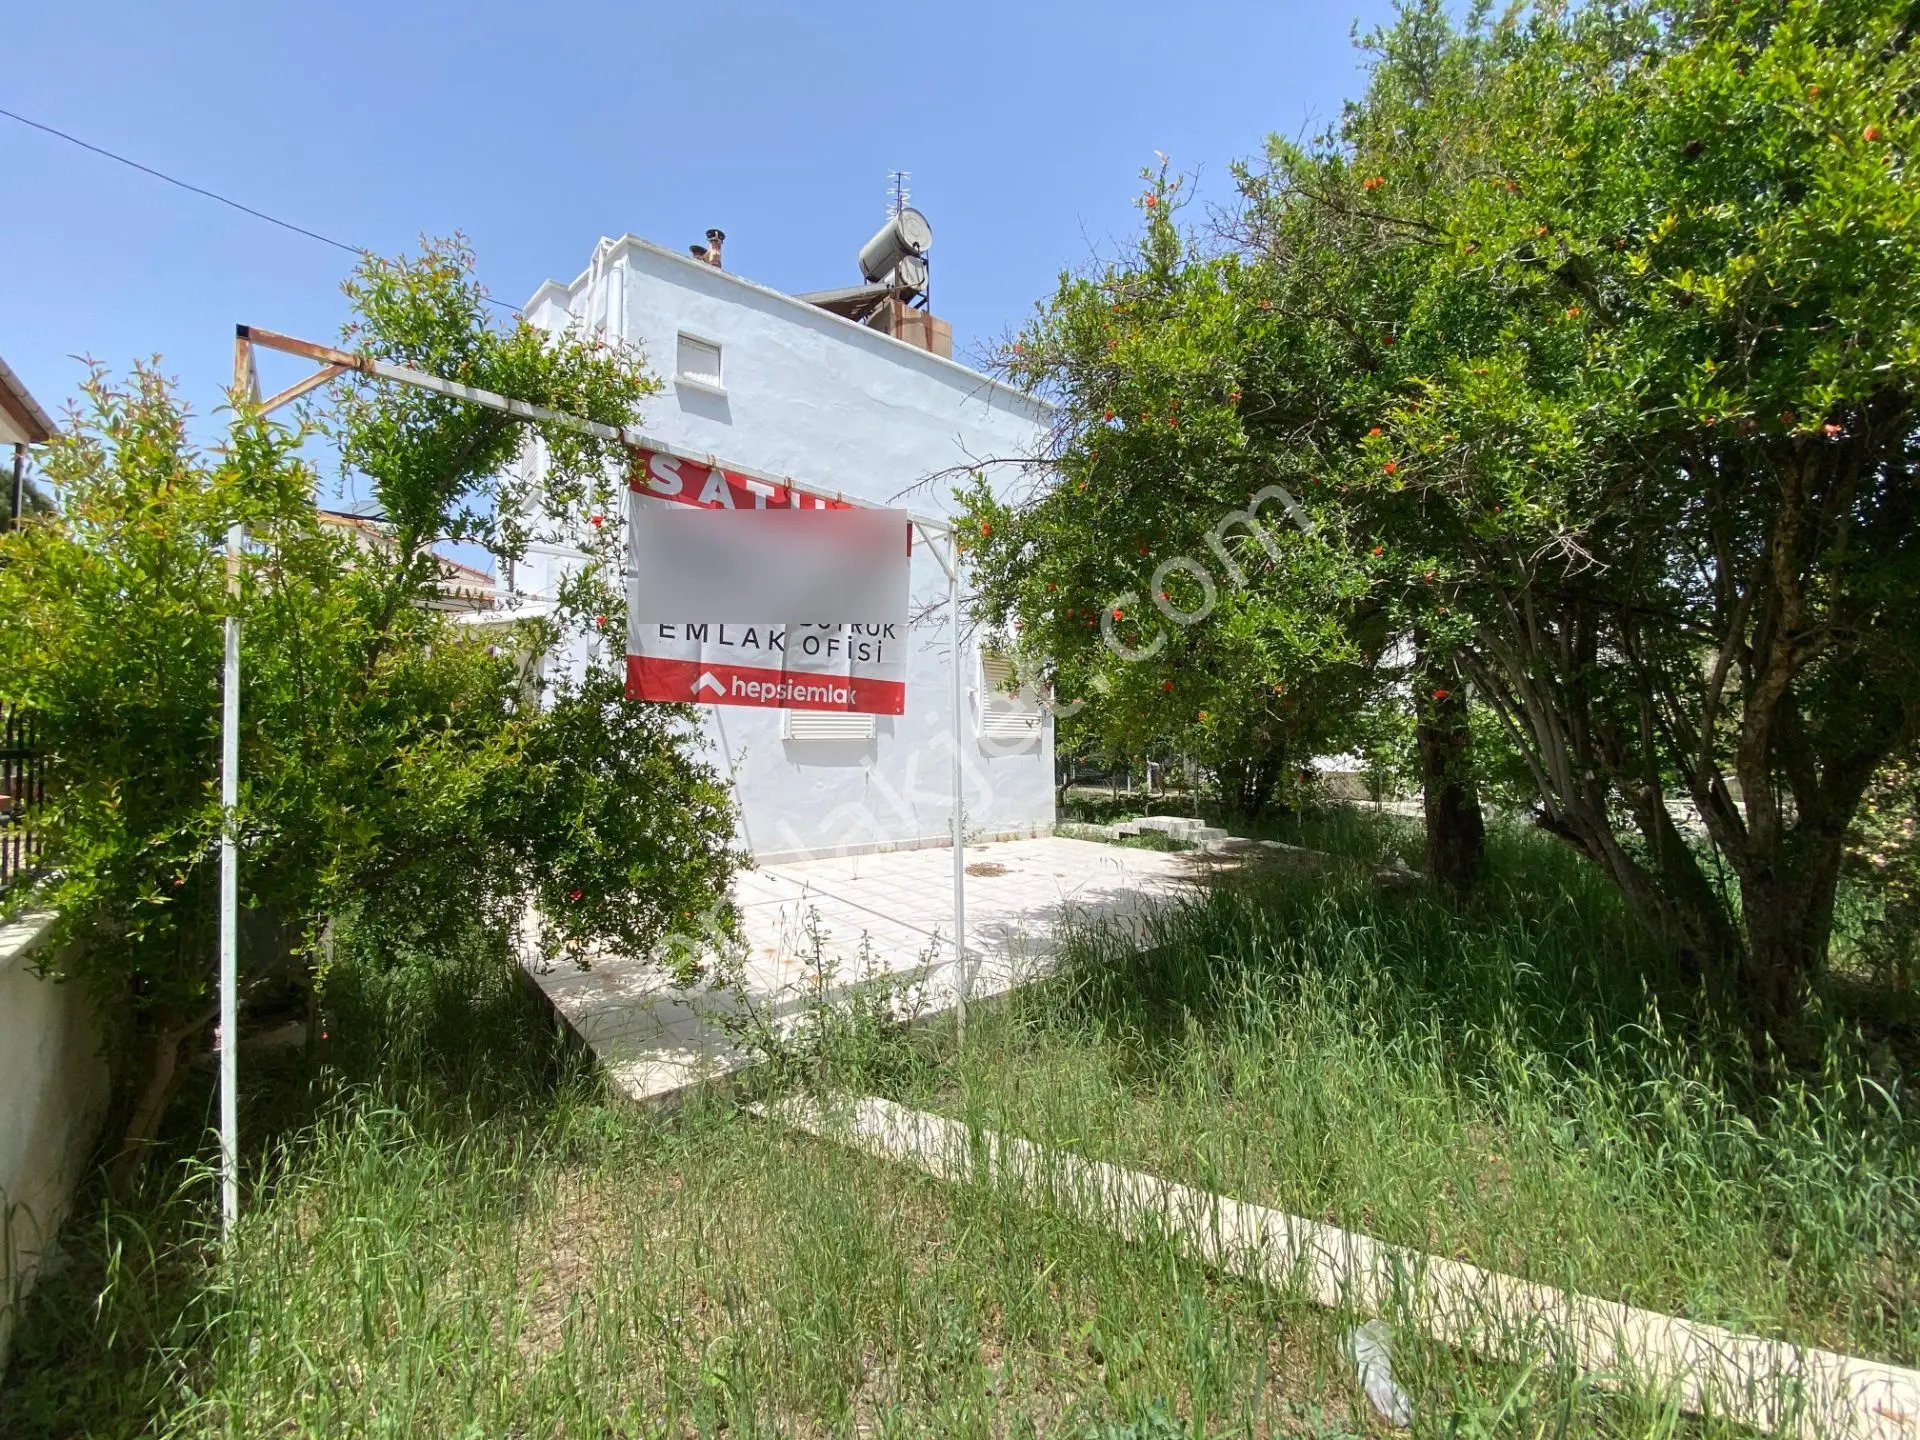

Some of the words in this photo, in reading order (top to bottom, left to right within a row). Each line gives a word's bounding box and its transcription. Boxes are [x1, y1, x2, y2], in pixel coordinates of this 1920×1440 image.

[659, 624, 786, 652] EMLAK
[802, 635, 882, 663] OFİSİ
[731, 675, 857, 705] hepsiemlak
